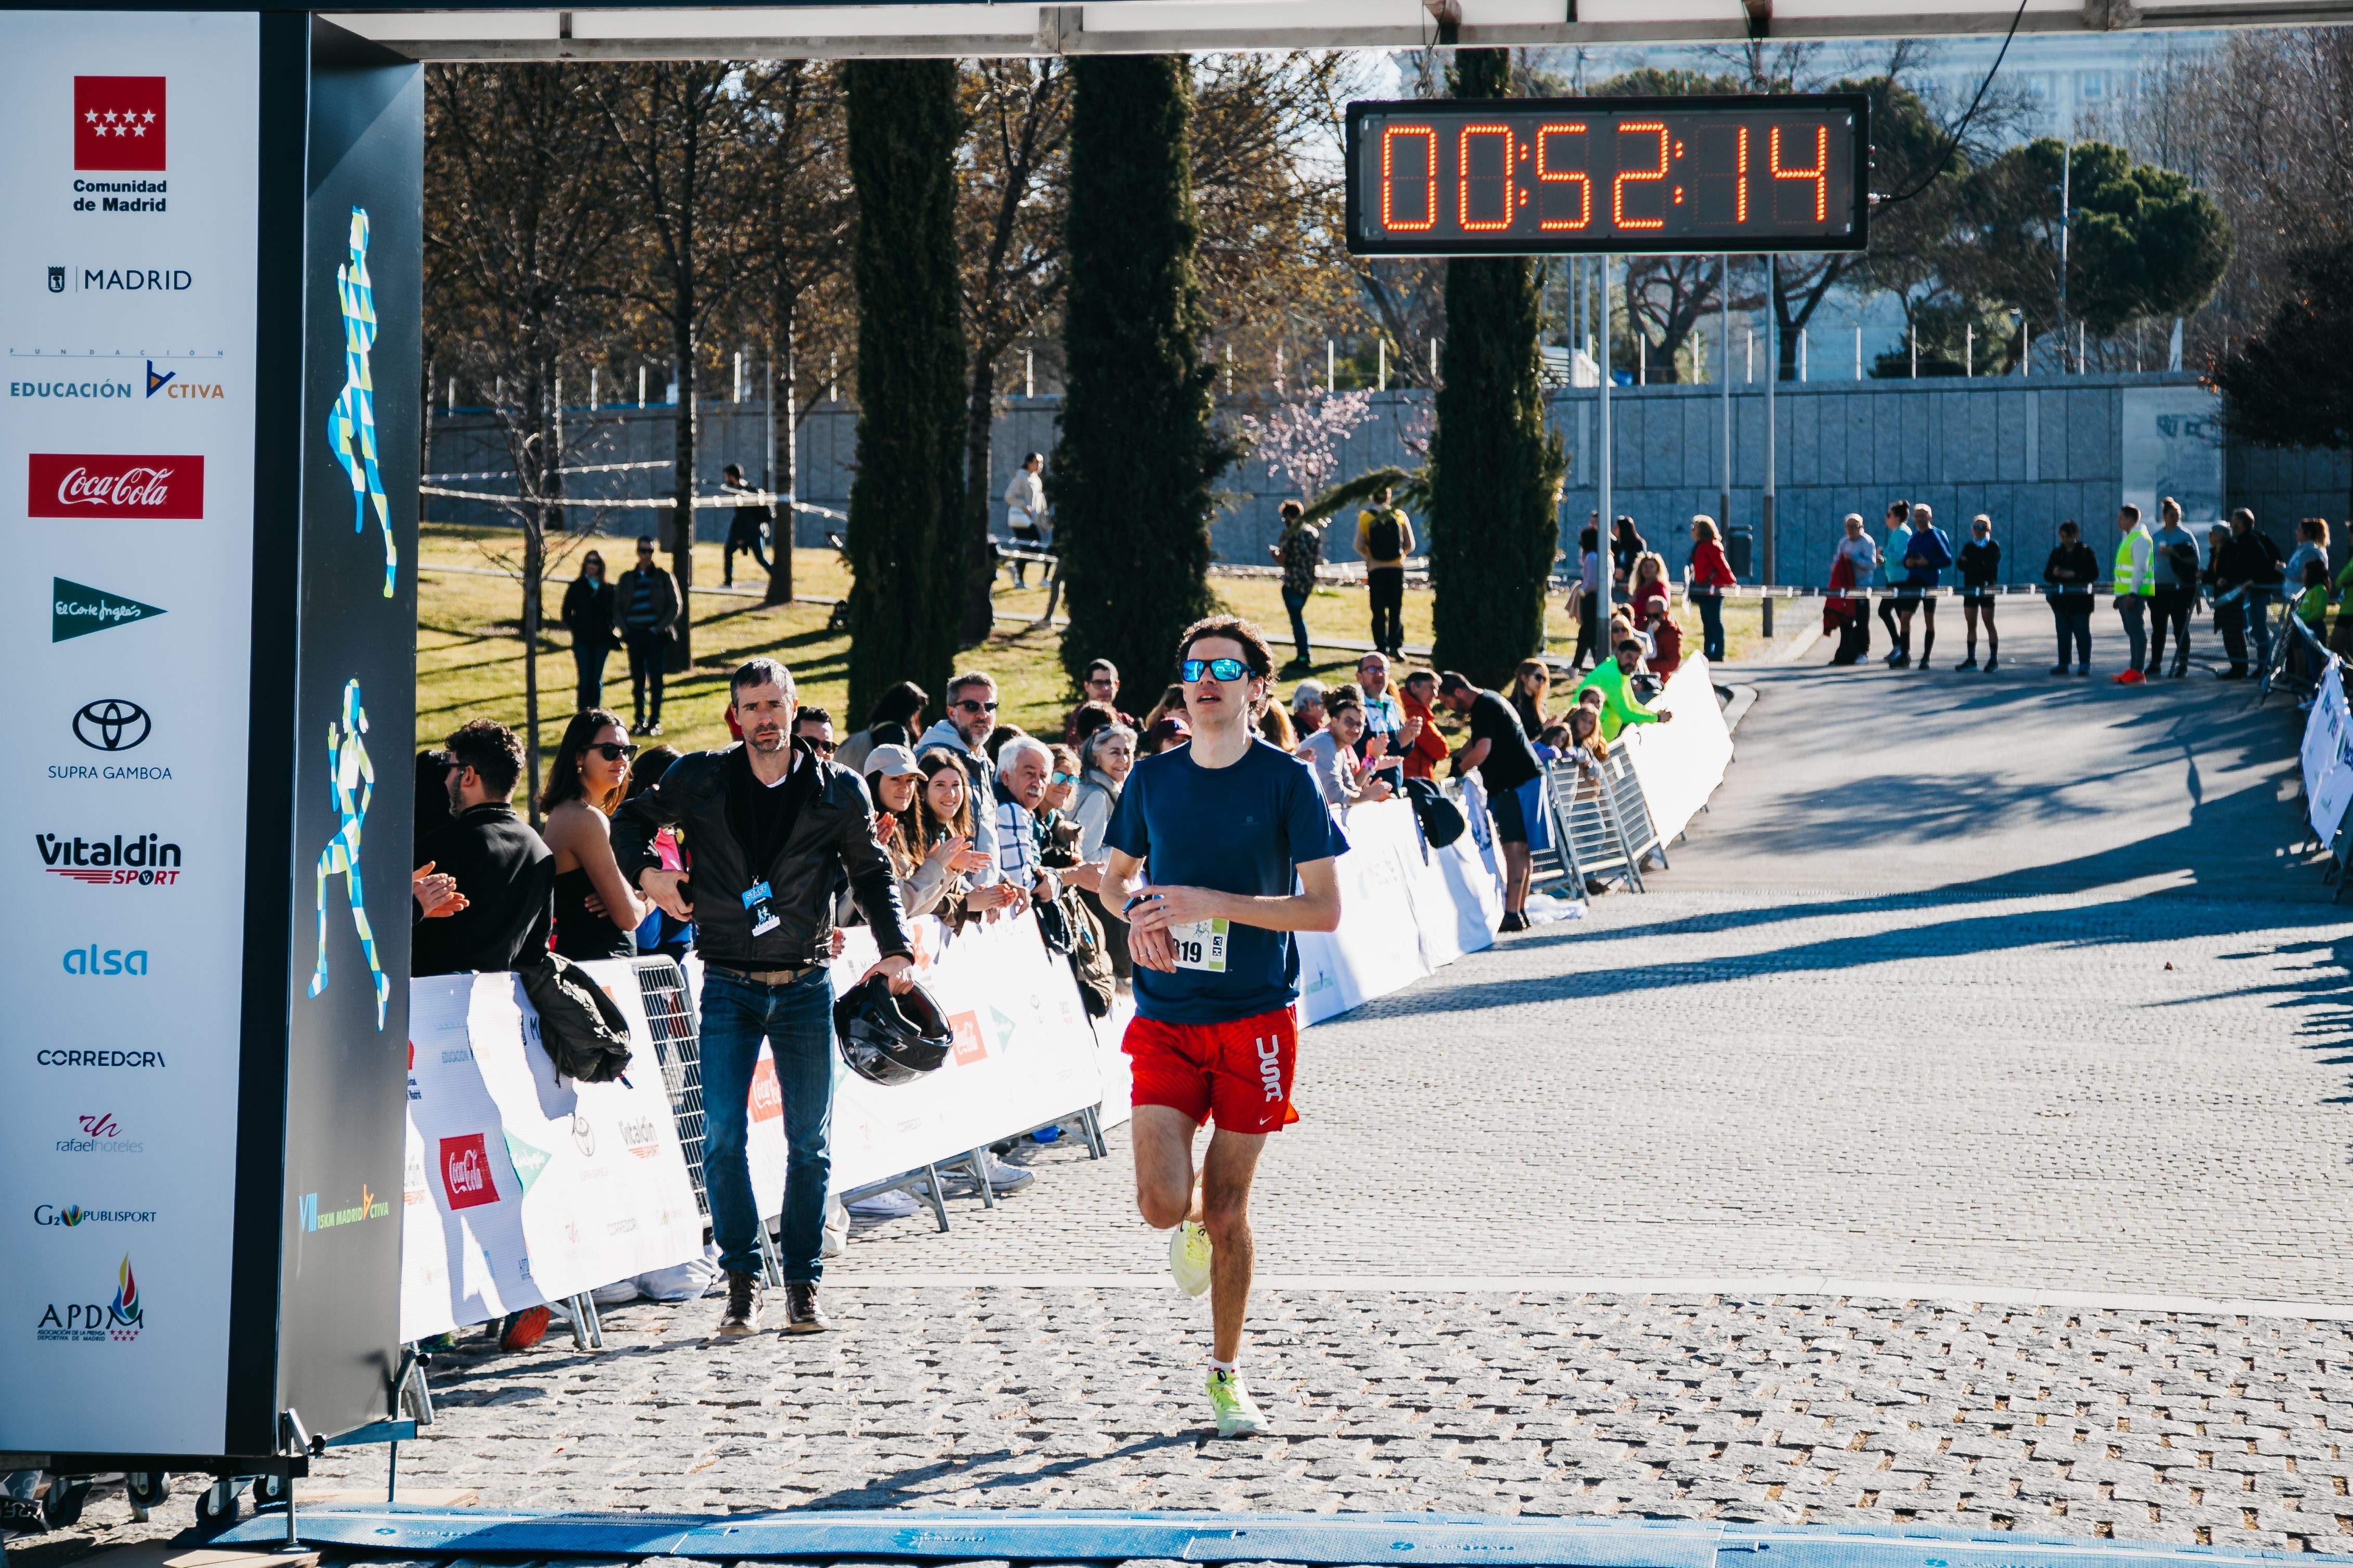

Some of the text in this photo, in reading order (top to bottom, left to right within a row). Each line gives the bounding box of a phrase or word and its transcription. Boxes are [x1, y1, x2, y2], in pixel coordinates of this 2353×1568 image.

[73, 180, 167, 193] Comunidad
[73, 197, 167, 212] de Madrid
[84, 270, 192, 290] MADRID
[10, 379, 131, 399] EDUCACIÓN
[58, 467, 174, 506] Coca-Cola
[55, 599, 142, 621] El Corte Inglés
[48, 766, 172, 780] SUPRA GAMBOA
[35, 833, 181, 867] Vitaldin
[112, 870, 181, 886] SPORT
[745, 885, 767, 901] STAFF
[62, 944, 148, 975] alsa
[1256, 1034, 1283, 1102] USA
[83, 1211, 157, 1222] PUBLISPORT
[317, 1212, 335, 1230] 15KM
[335, 1207, 363, 1226] MADRID
[37, 1303, 144, 1330] APDM
